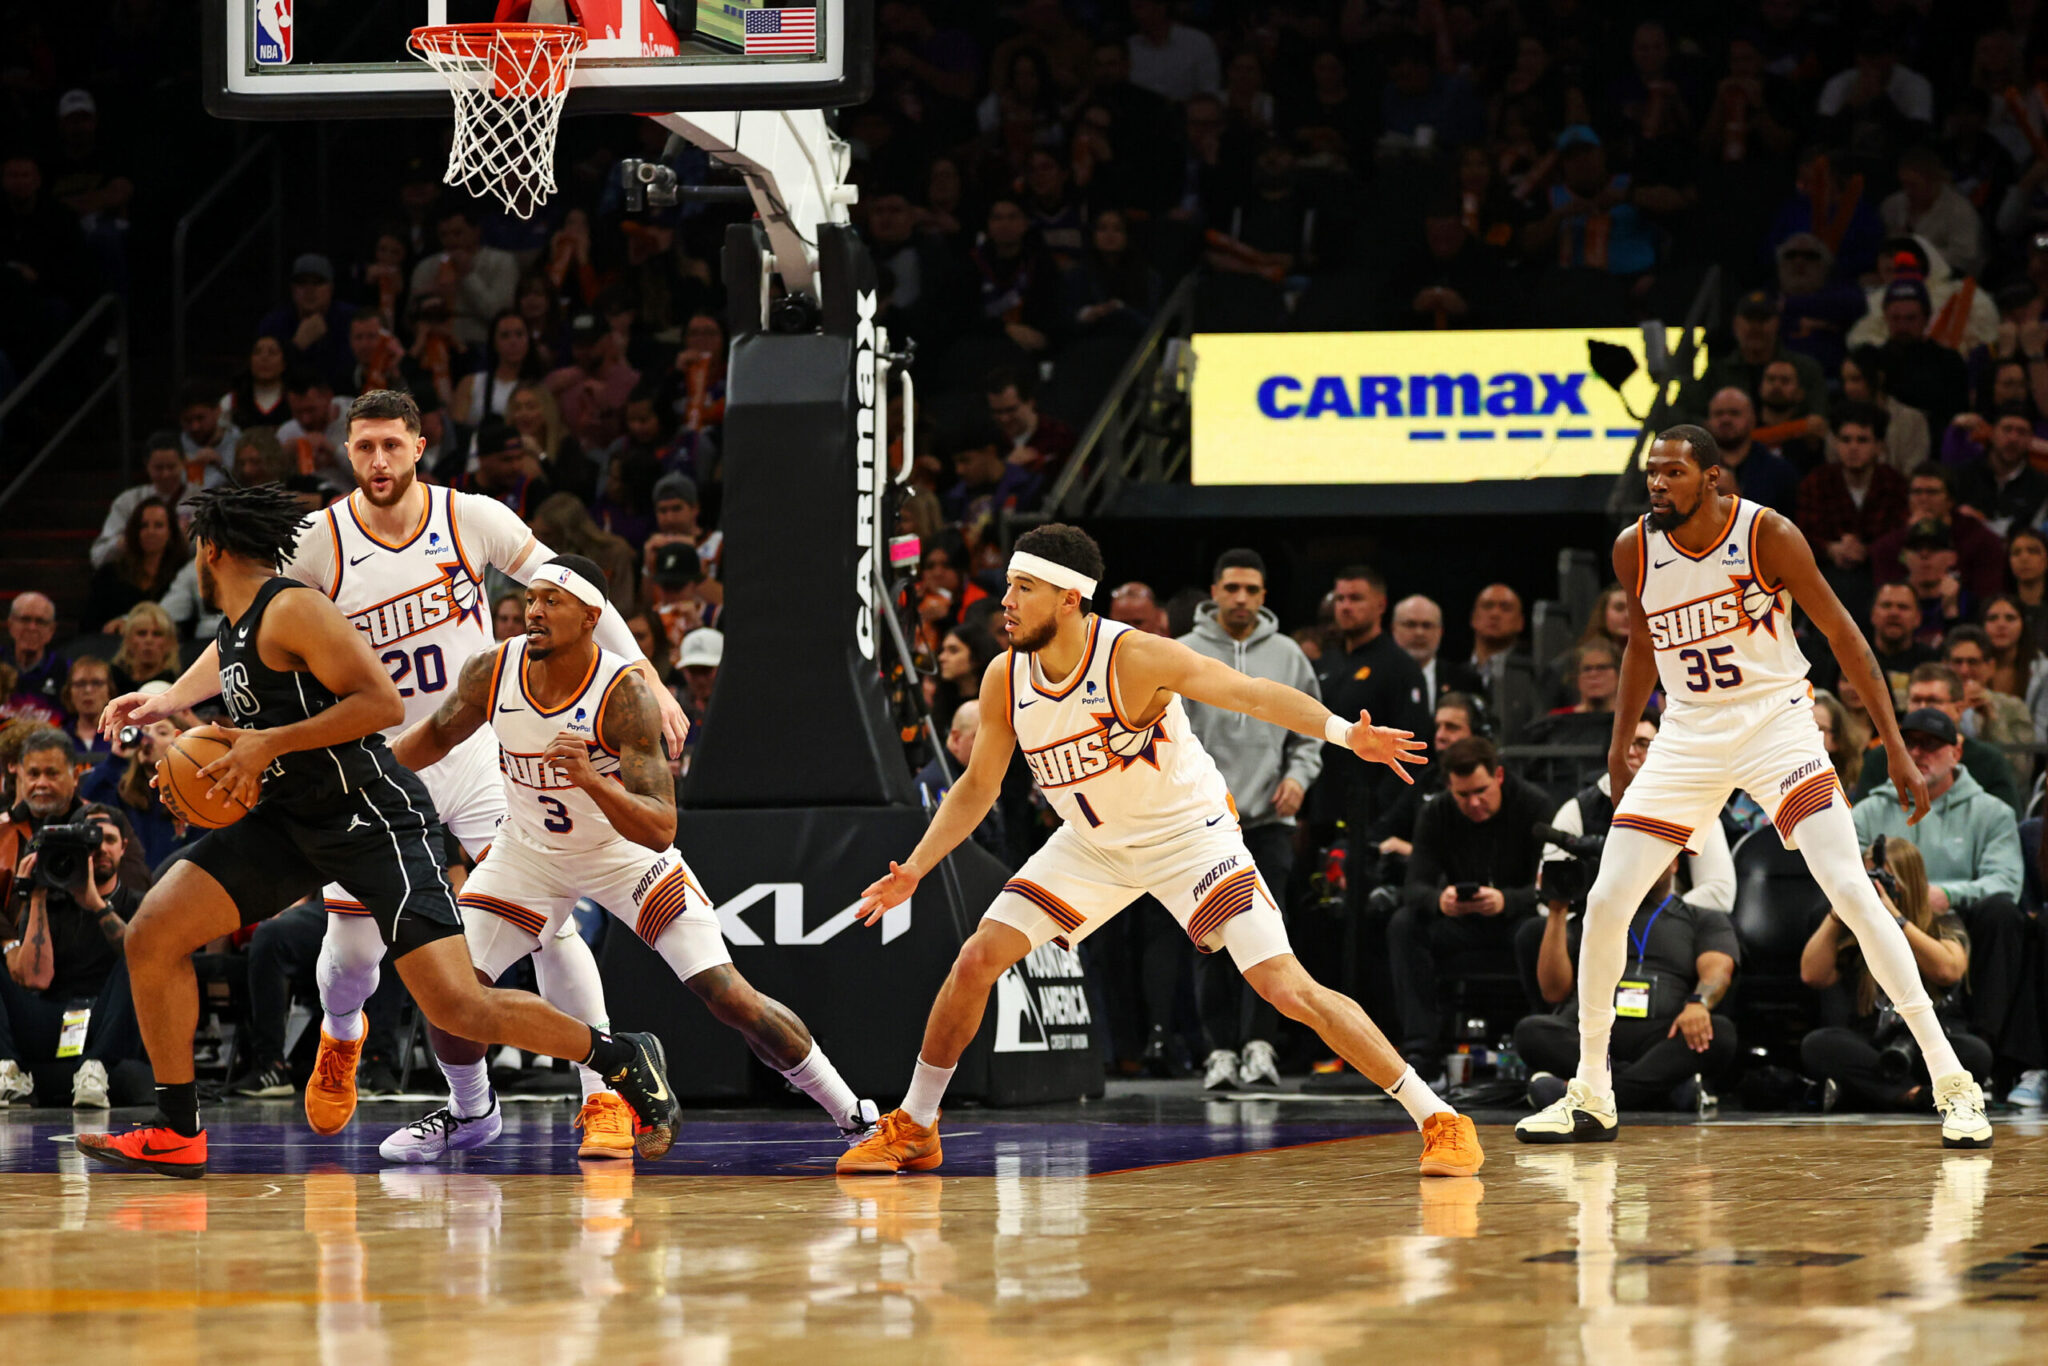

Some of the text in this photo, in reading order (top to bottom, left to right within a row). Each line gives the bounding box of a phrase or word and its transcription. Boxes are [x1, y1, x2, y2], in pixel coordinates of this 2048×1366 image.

[260, 44, 278, 59] NBA
[425, 546, 449, 556] PayPal
[1722, 558, 1745, 566] PayPal
[1647, 593, 1739, 650] SUNS
[381, 644, 448, 698] 20
[1679, 645, 1744, 693] 35
[1082, 696, 1105, 705] PayPal
[567, 722, 591, 733] PayPal
[1779, 757, 1823, 796] PHOENIX
[538, 795, 574, 834] 3
[1073, 792, 1104, 829] 1
[632, 856, 669, 907] PHOENIX
[1192, 855, 1239, 903] PHOENIX
[1038, 985, 1092, 1026] AMERICA
